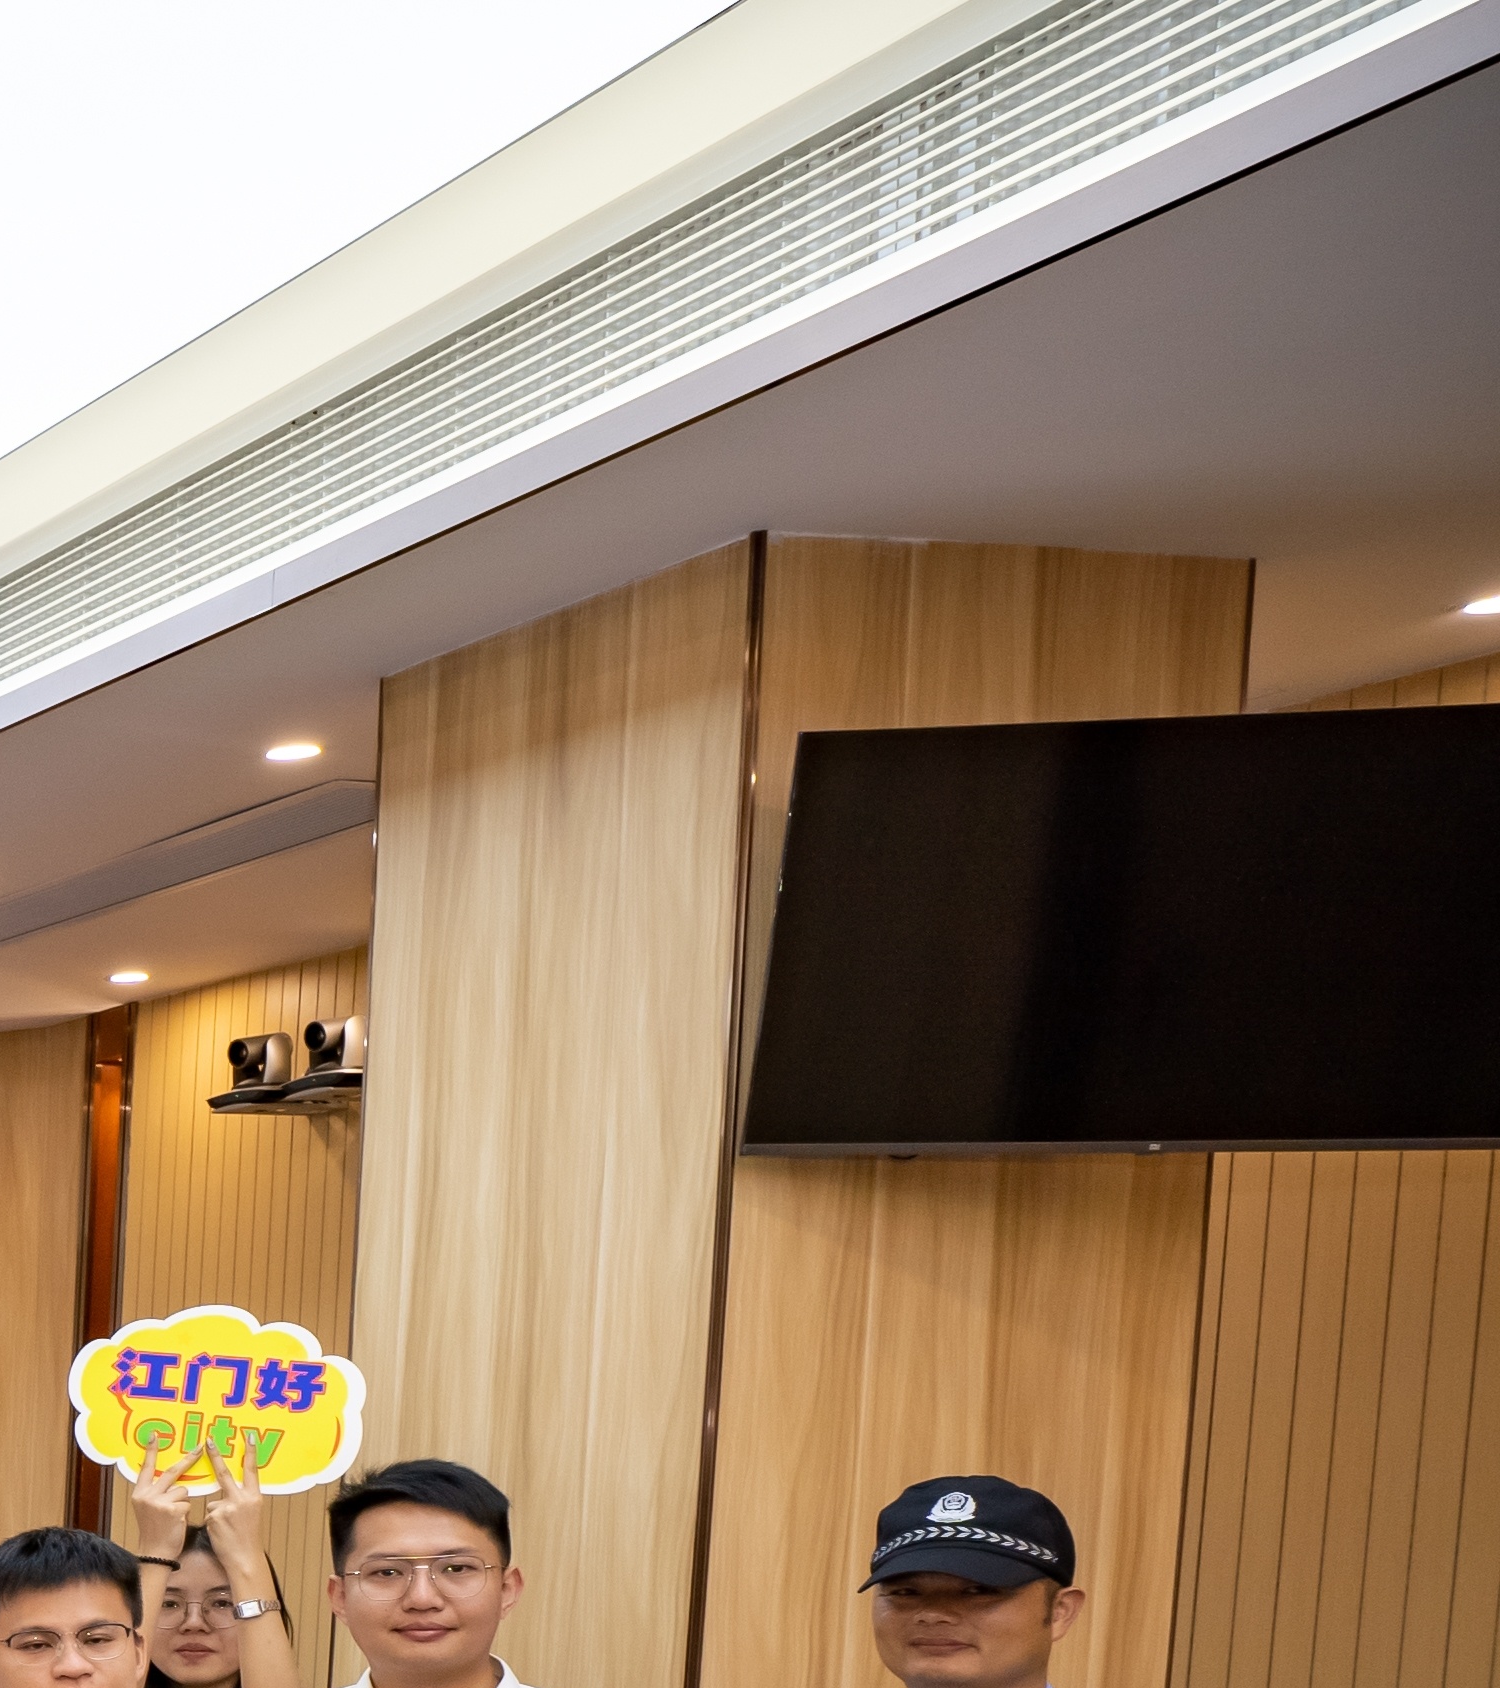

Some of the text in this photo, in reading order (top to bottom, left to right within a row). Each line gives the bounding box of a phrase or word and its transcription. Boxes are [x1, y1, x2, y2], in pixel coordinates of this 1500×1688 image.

[107, 1347, 326, 1413] 江门好
[134, 1411, 285, 1469] city
